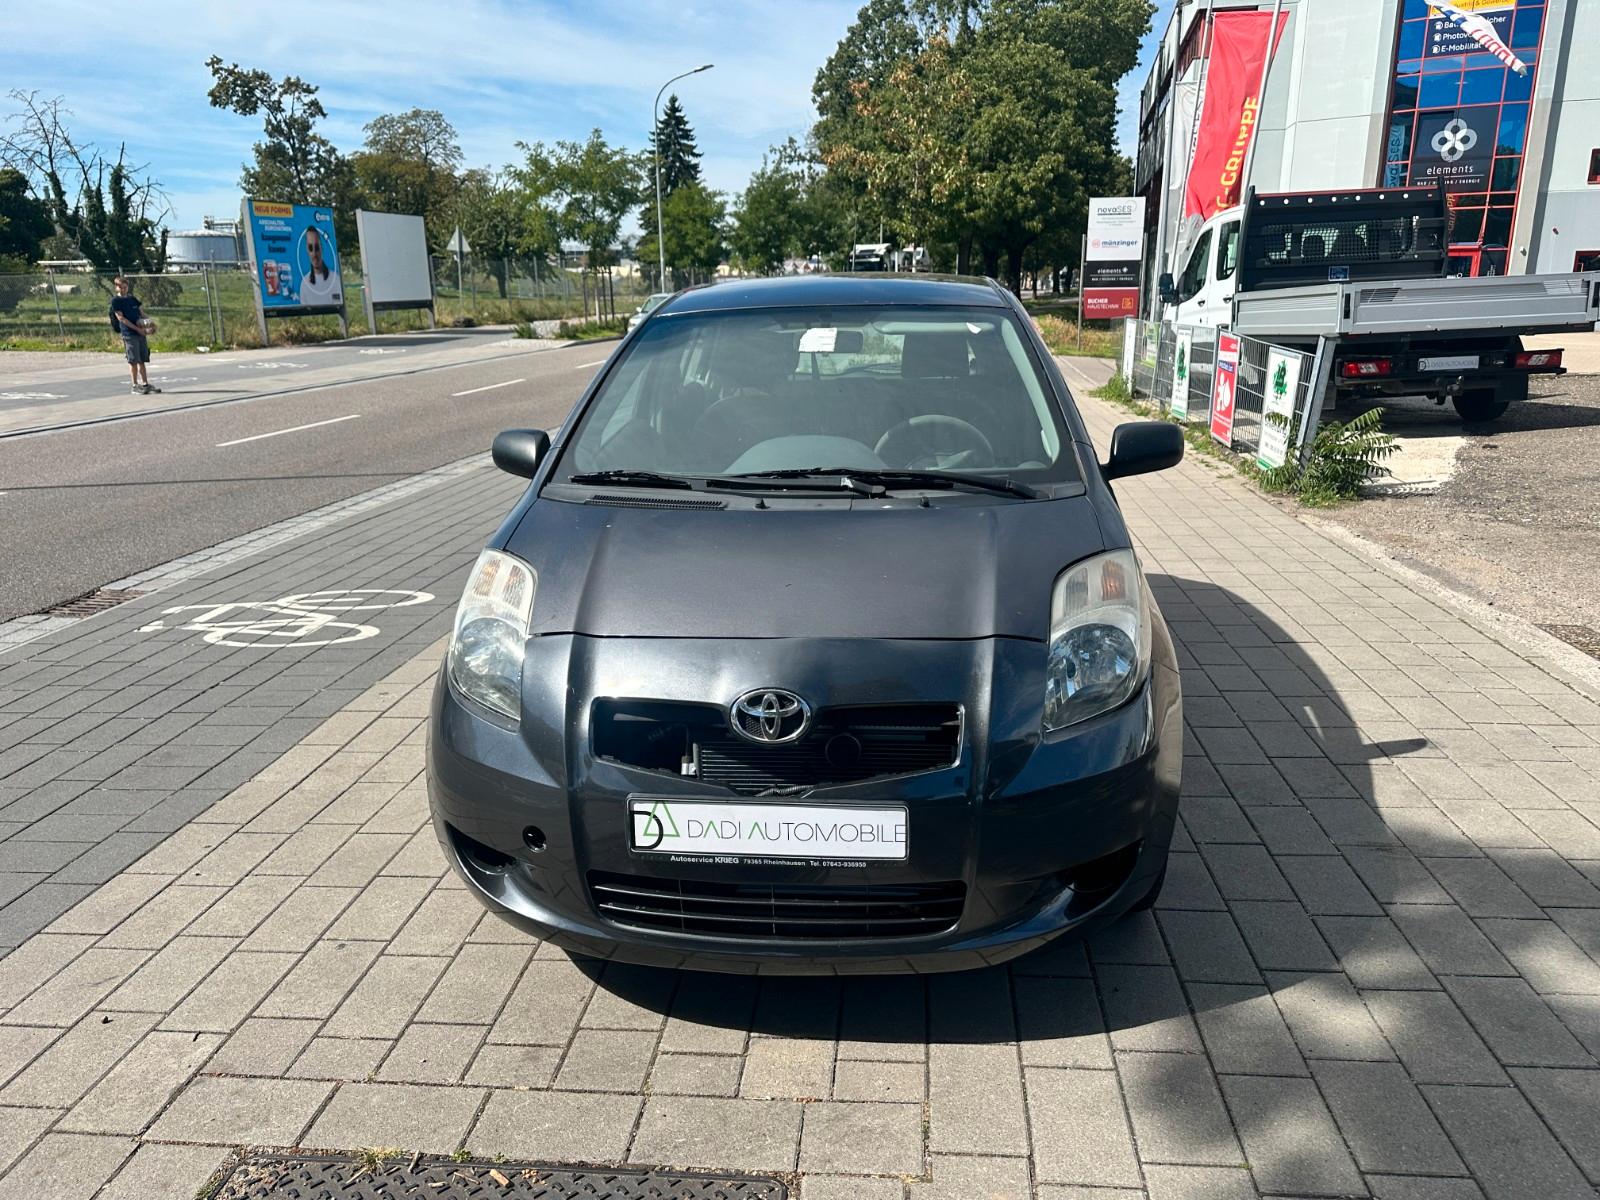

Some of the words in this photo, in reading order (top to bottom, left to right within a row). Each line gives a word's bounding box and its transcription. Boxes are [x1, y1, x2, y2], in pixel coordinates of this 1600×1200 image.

[1427, 165, 1474, 175] elements
[687, 819, 742, 839] DADI
[748, 821, 907, 843] AUTOMOBILE
[670, 855, 713, 863] Autoservice
[714, 856, 739, 864] KRIEG
[763, 858, 805, 866] Rheinhausen
